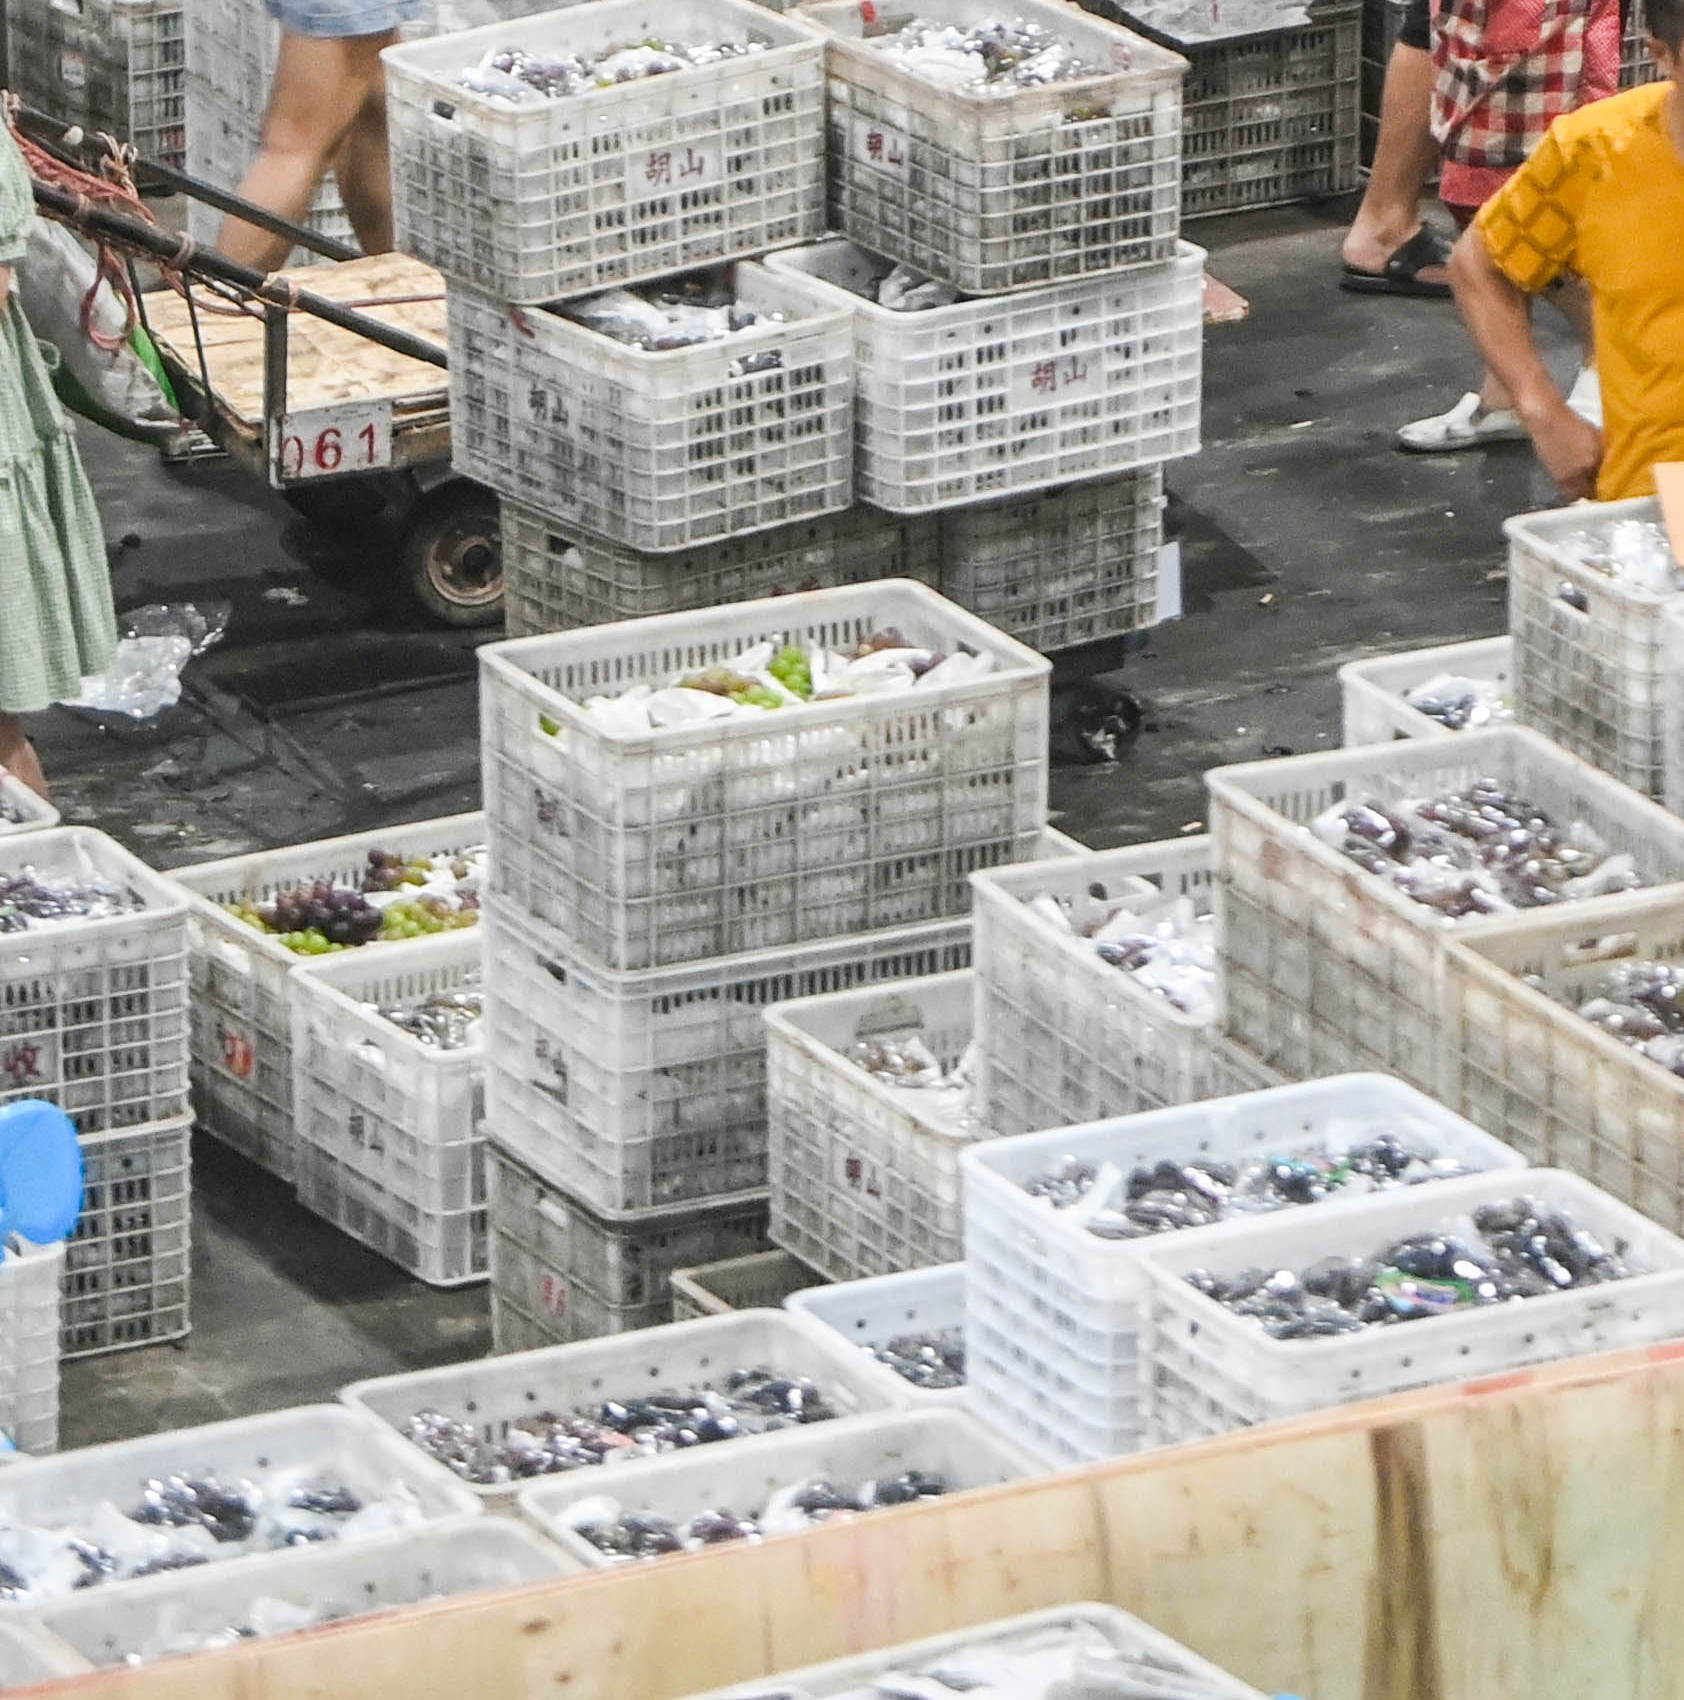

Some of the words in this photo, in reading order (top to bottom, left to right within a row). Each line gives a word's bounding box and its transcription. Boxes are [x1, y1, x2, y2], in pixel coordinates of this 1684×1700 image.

[646, 148, 705, 186] 胡山
[1032, 356, 1087, 392] 胡山
[283, 423, 377, 478] 061
